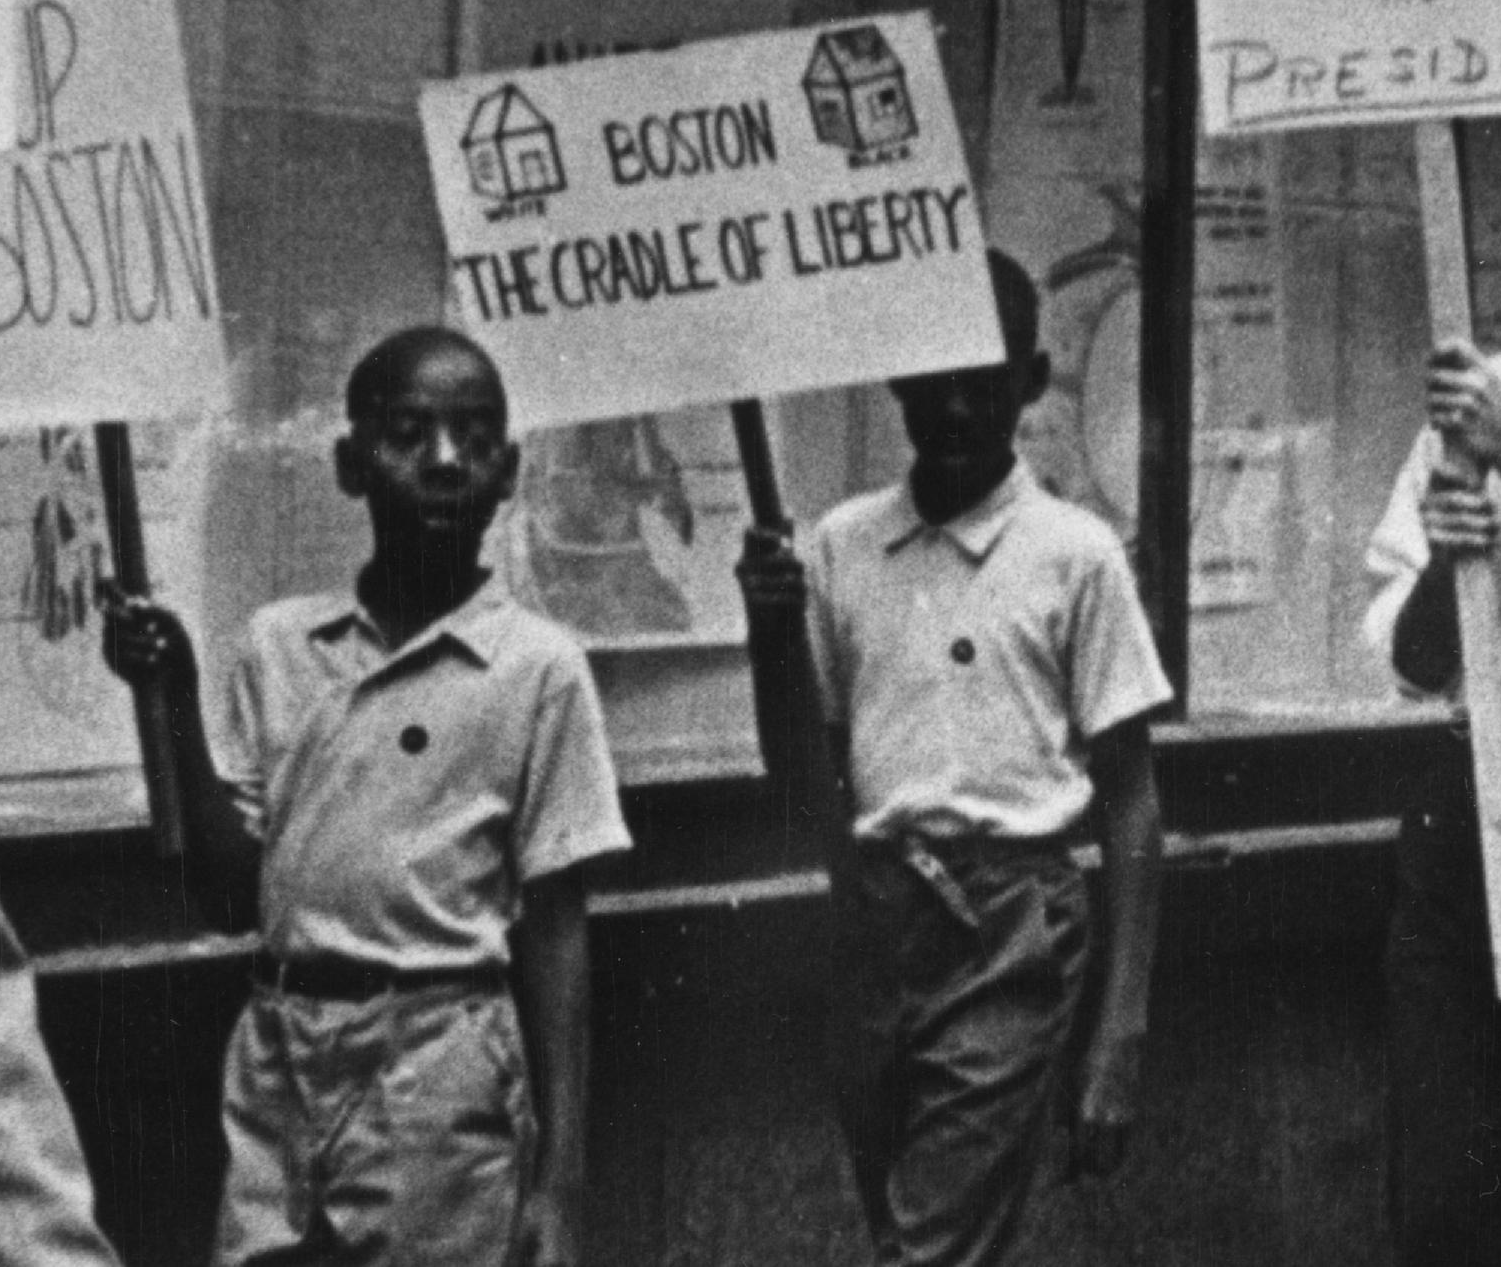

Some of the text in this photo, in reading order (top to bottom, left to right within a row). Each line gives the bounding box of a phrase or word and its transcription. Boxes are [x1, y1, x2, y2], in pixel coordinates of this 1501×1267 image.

[603, 100, 777, 186] BOSTON
[455, 184, 968, 321] THE CRADLE OF LIBERTY
